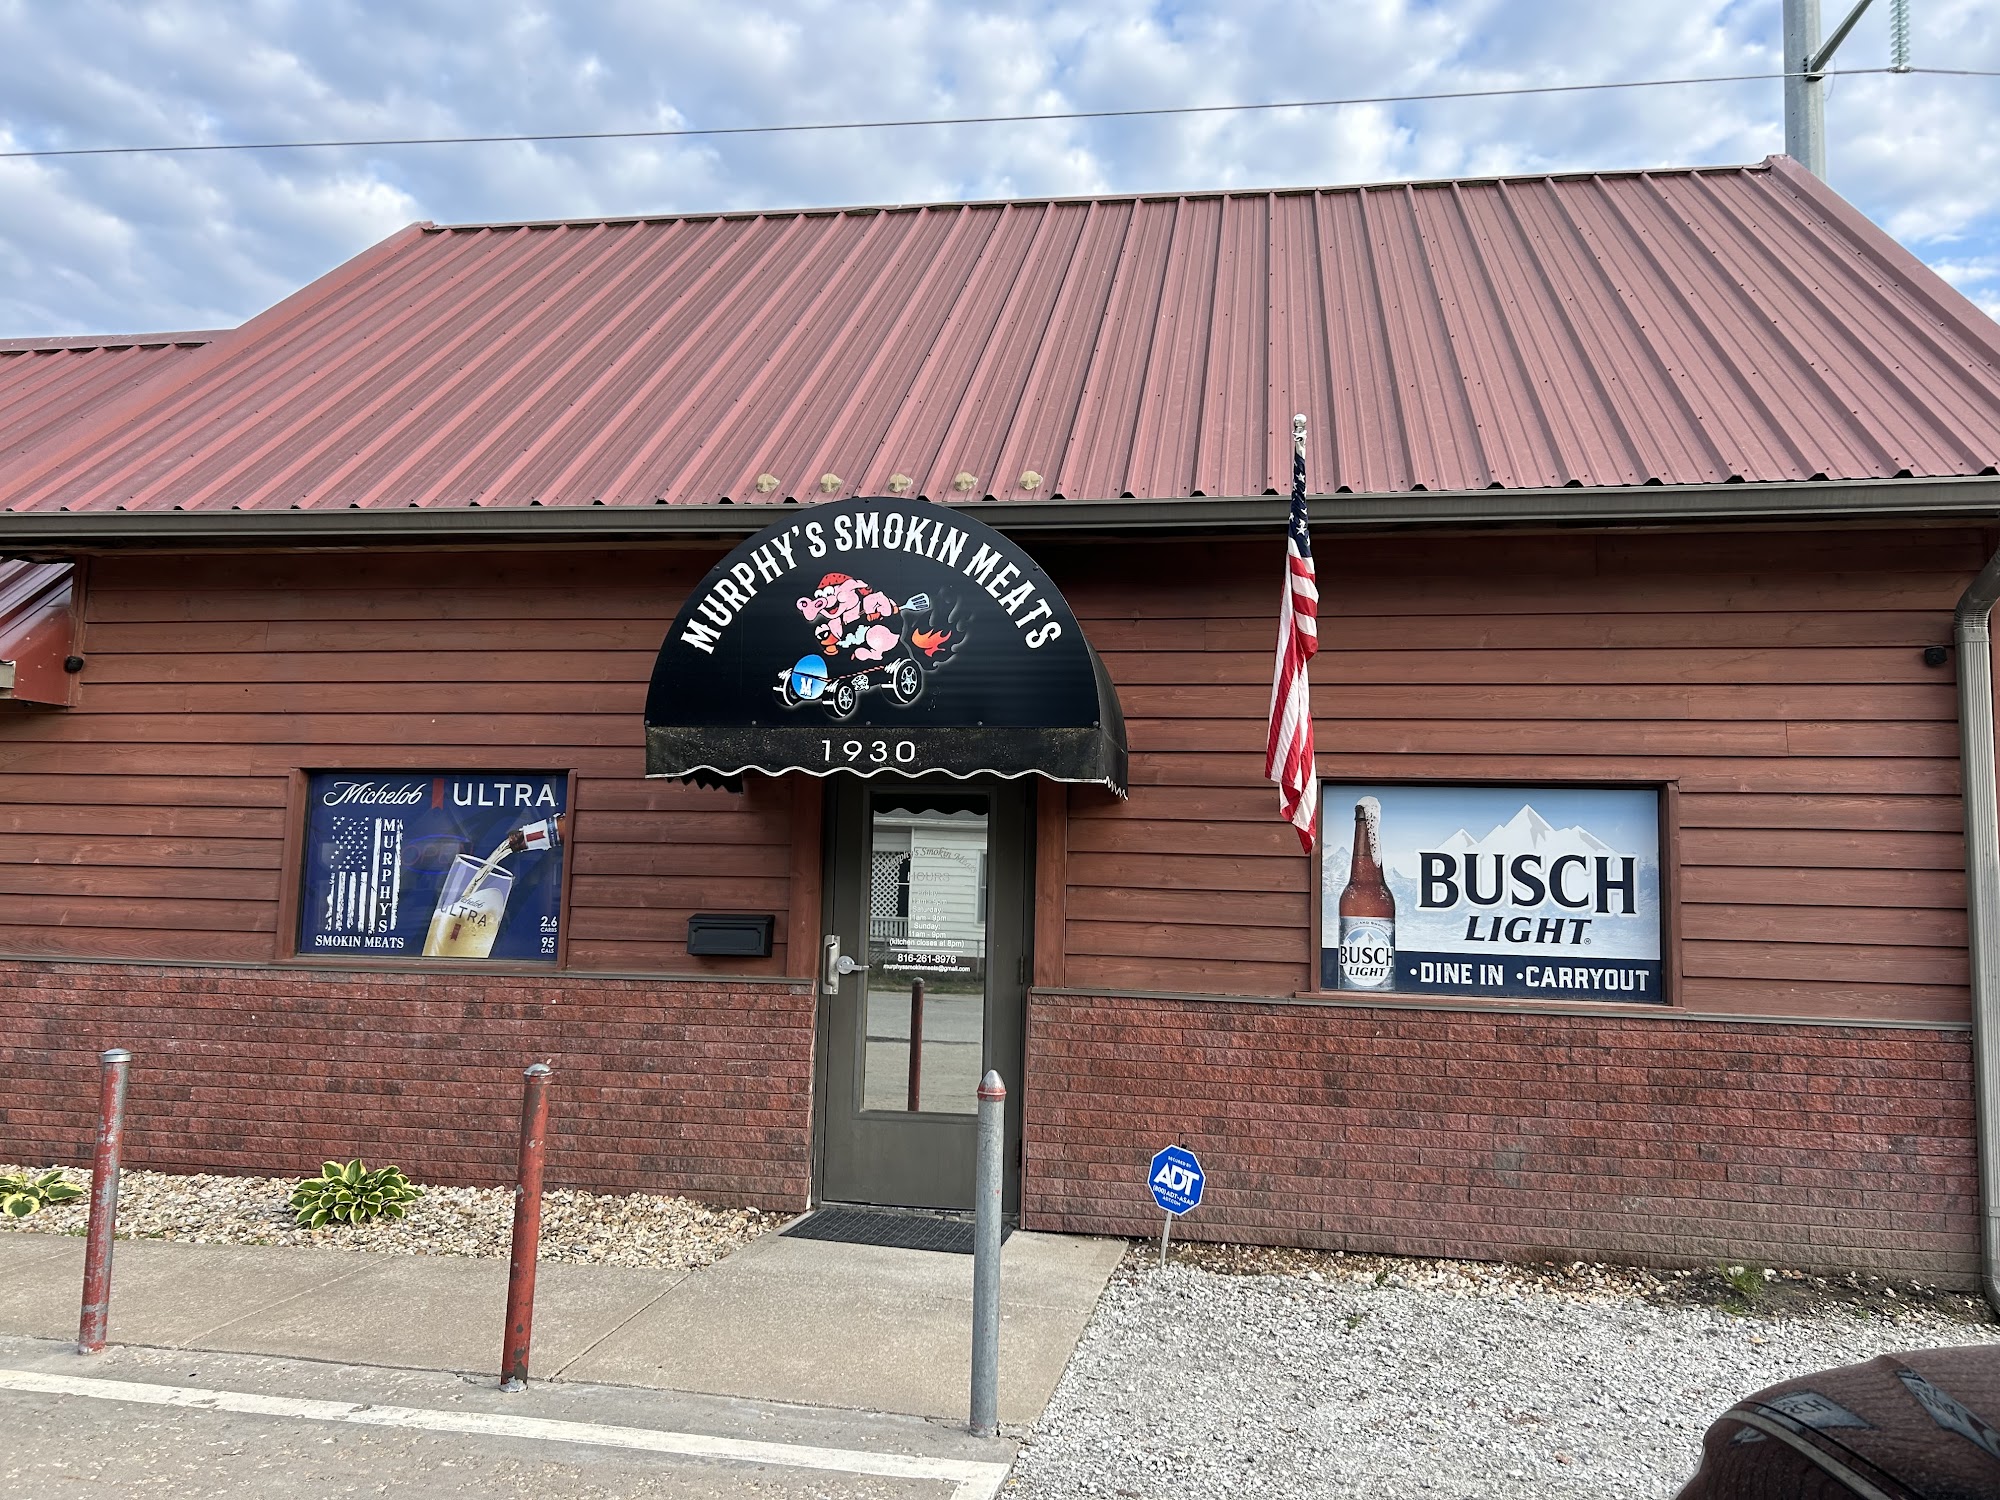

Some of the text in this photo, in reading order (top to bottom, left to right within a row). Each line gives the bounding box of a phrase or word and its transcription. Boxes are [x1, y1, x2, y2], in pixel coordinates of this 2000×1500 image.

[680, 511, 1063, 655] MURPHY'S SMOKIN MEATS
[800, 677, 813, 697] M
[821, 739, 916, 764] 1930
[323, 781, 556, 807] Michelob ULTRA
[907, 872, 951, 882] HOURS
[1418, 851, 1637, 915] BUSCH
[540, 916, 558, 927] 2.6
[1464, 915, 1592, 945] LIGHT
[315, 934, 404, 949] SMOKIN MEATS
[541, 937, 555, 948] 95
[897, 953, 957, 964] 816-261-8976
[1340, 945, 1394, 967] BUSCH
[1349, 966, 1385, 977] LIGHT
[1479, 964, 1504, 986] IN
[1153, 1162, 1200, 1196] ADT
